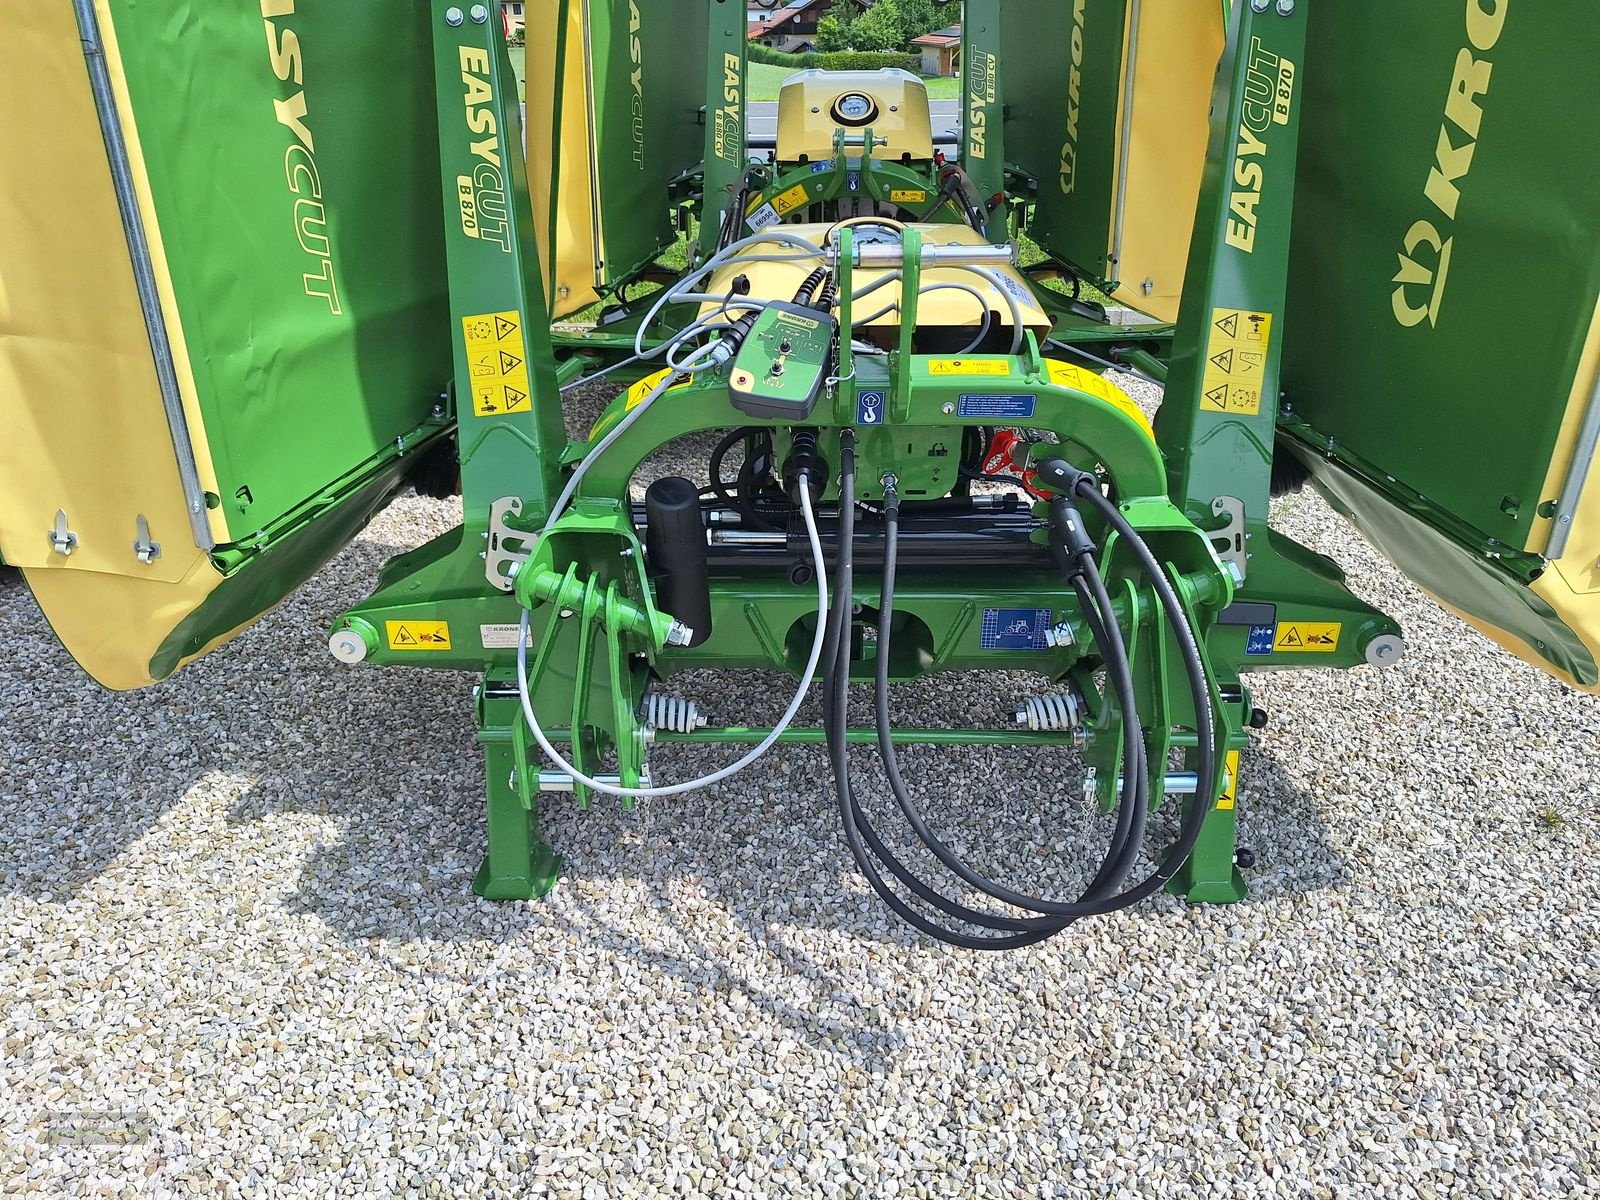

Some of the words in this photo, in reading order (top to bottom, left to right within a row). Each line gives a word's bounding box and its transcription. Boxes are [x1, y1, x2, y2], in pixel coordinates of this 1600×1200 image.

[988, 58, 994, 71] CV
[1278, 69, 1292, 100] 870
[724, 52, 740, 168] EASYCUT
[970, 44, 986, 159] EASYCUT
[1276, 104, 1288, 116] B
[458, 46, 512, 253] EASYCUT
[716, 141, 722, 154] CV
[1225, 36, 1278, 253] EASYCUT
[460, 184, 472, 196] B
[462, 201, 476, 228] 870
[754, 210, 774, 227] 66950
